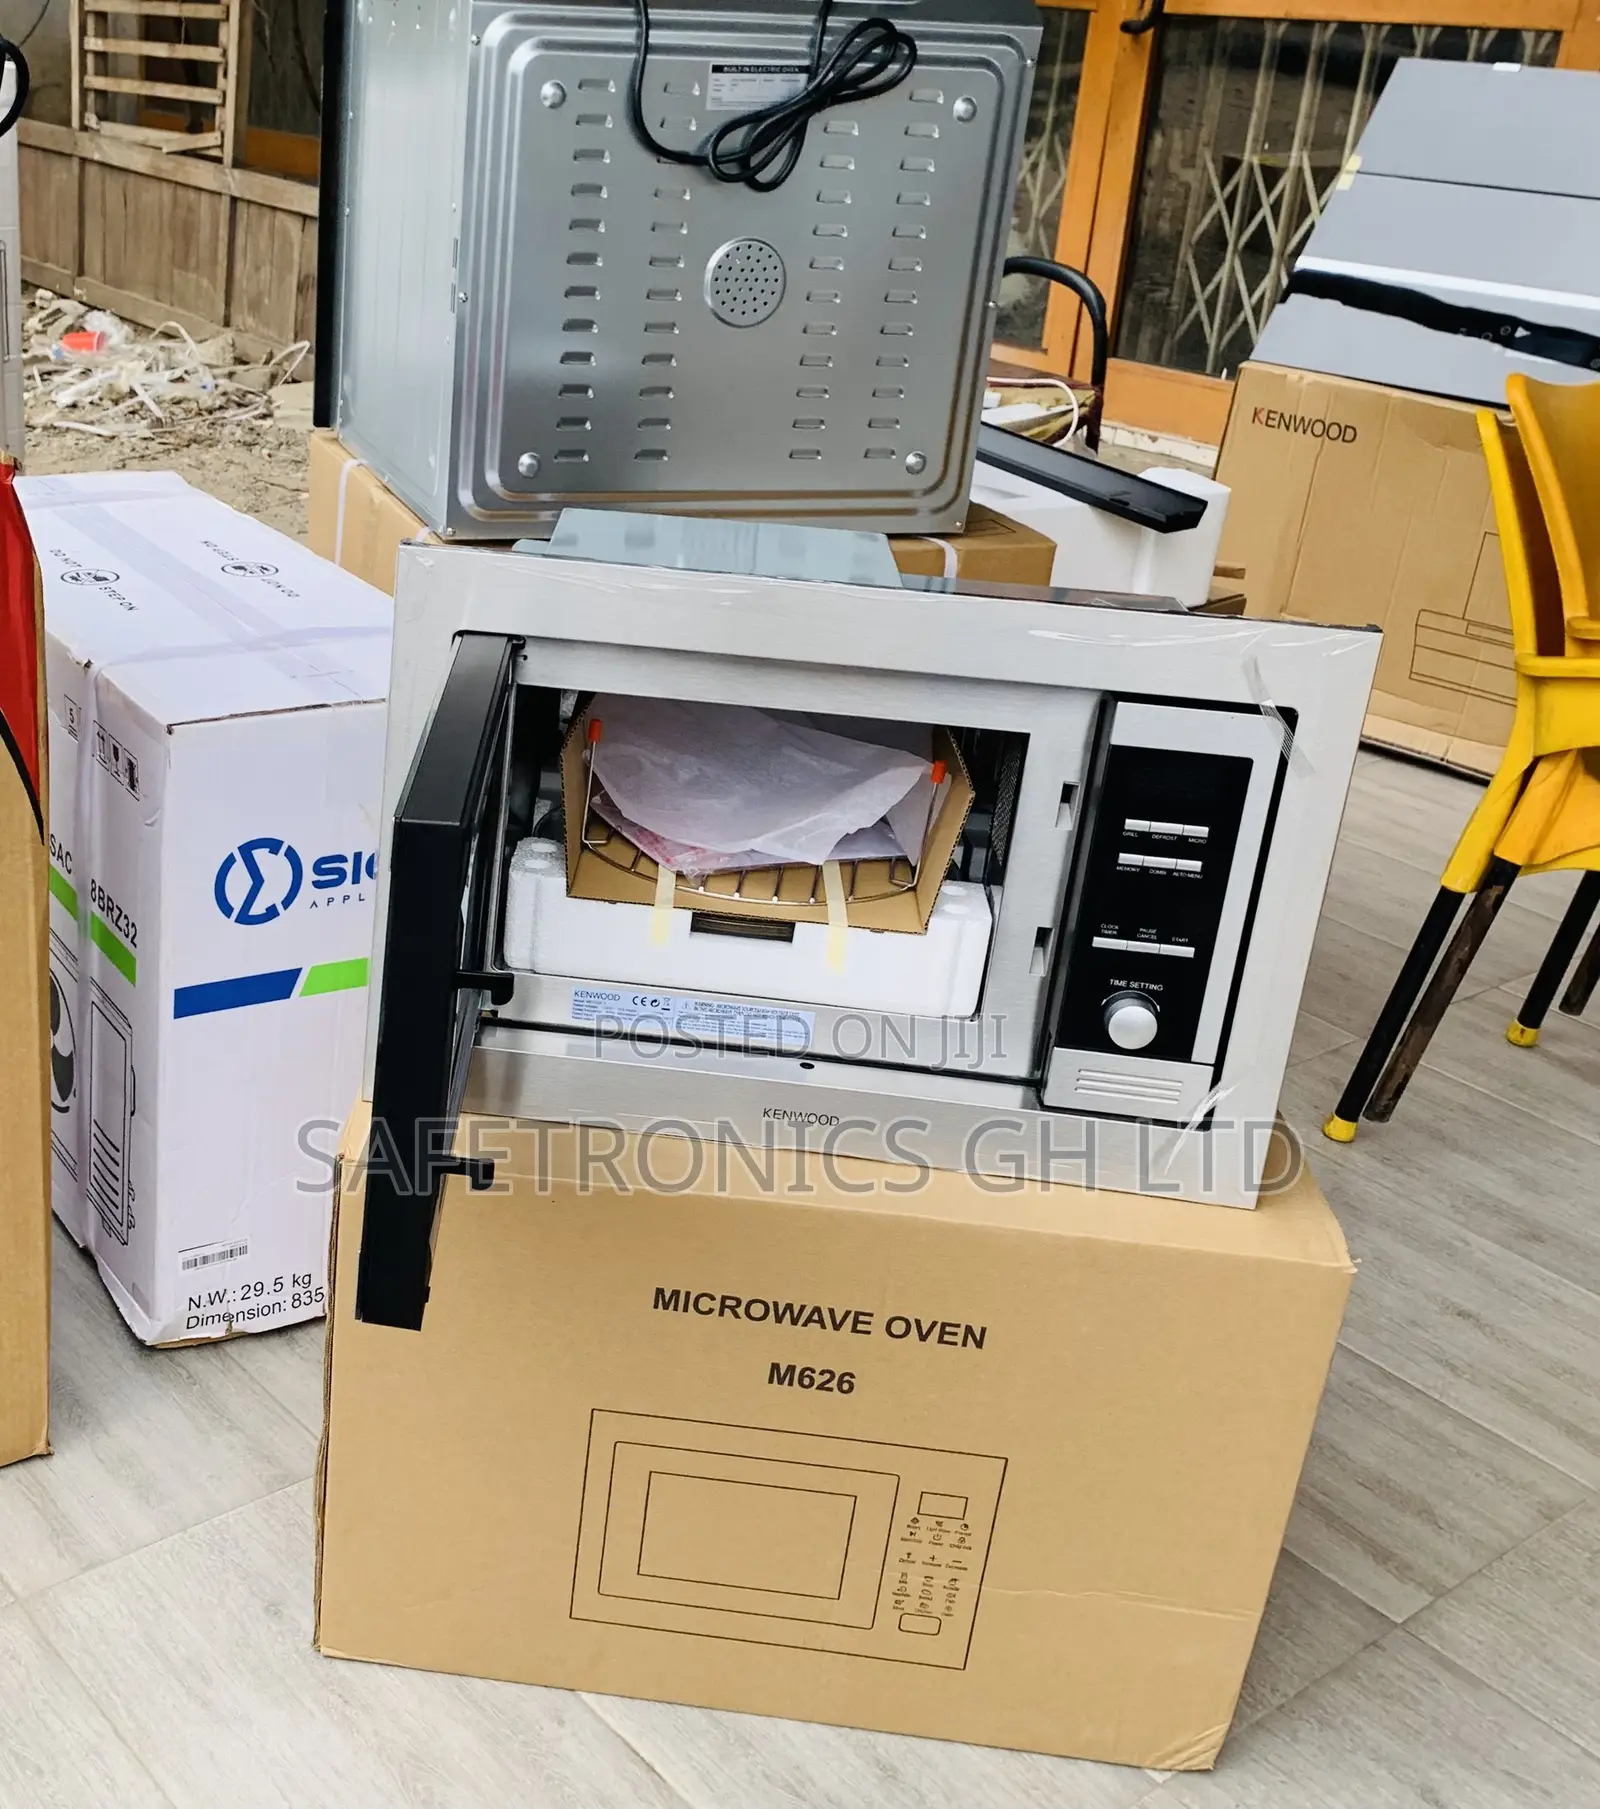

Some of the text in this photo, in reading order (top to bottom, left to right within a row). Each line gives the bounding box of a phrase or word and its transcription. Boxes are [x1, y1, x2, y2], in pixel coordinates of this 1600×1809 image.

[1251, 406, 1357, 443] KENWOOD
[574, 990, 621, 1002] KENWOOD
[1109, 979, 1164, 992] TIME SETTING
[762, 1107, 840, 1127] KENWOOD
[292, 1273, 312, 1289] kg
[186, 1286, 325, 1330] Dimension: 835
[652, 1287, 987, 1350] MICROWAVE OVEN
[767, 1362, 856, 1395] M626
